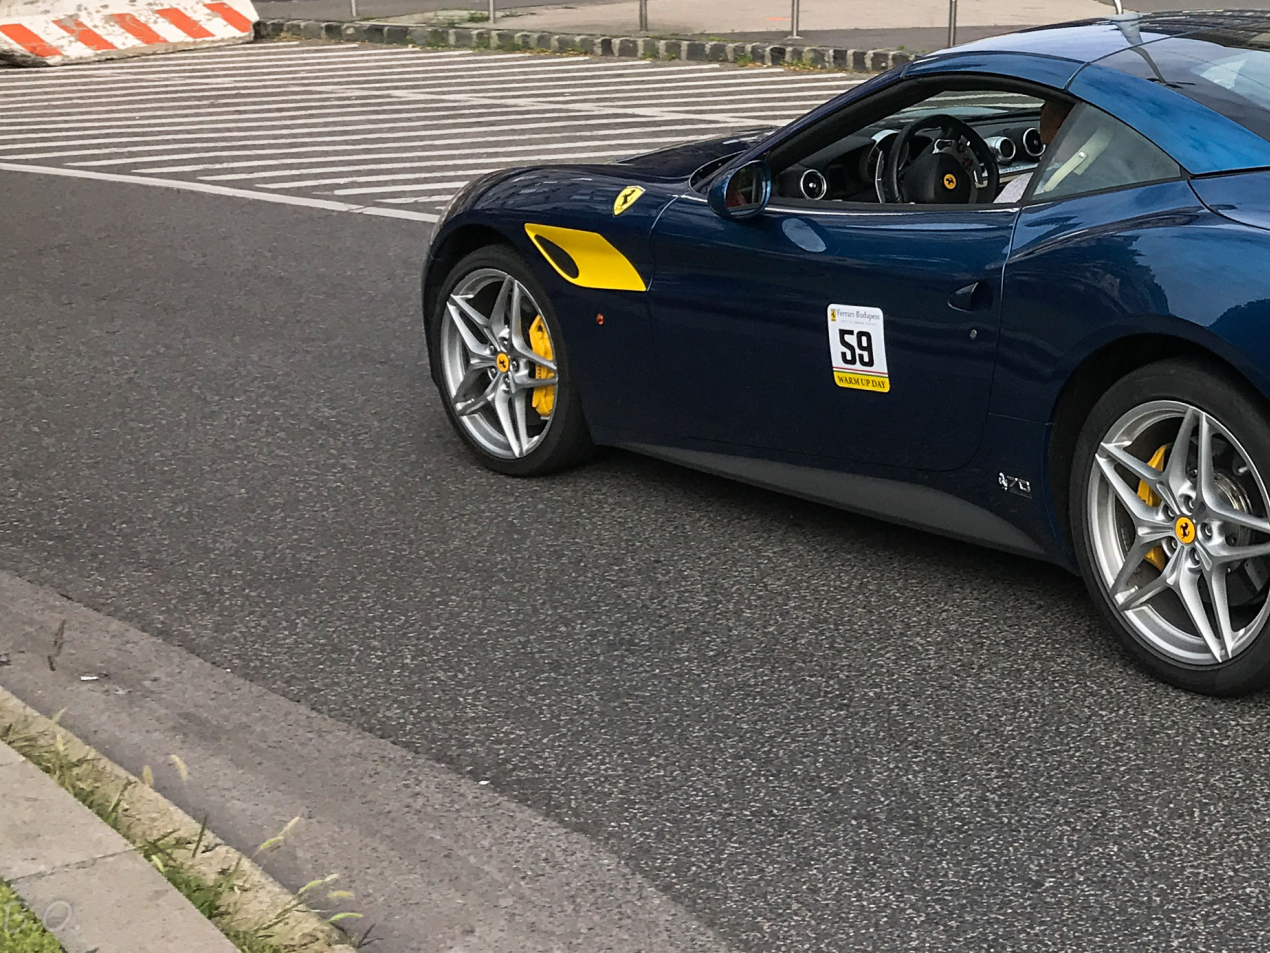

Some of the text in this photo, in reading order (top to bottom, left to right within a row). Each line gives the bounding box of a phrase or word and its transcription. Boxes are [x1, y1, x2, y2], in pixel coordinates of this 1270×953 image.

[837, 309, 880, 321] Ferrari Budapest
[838, 328, 875, 368] 59
[837, 375, 886, 389] WARM UP DAY
